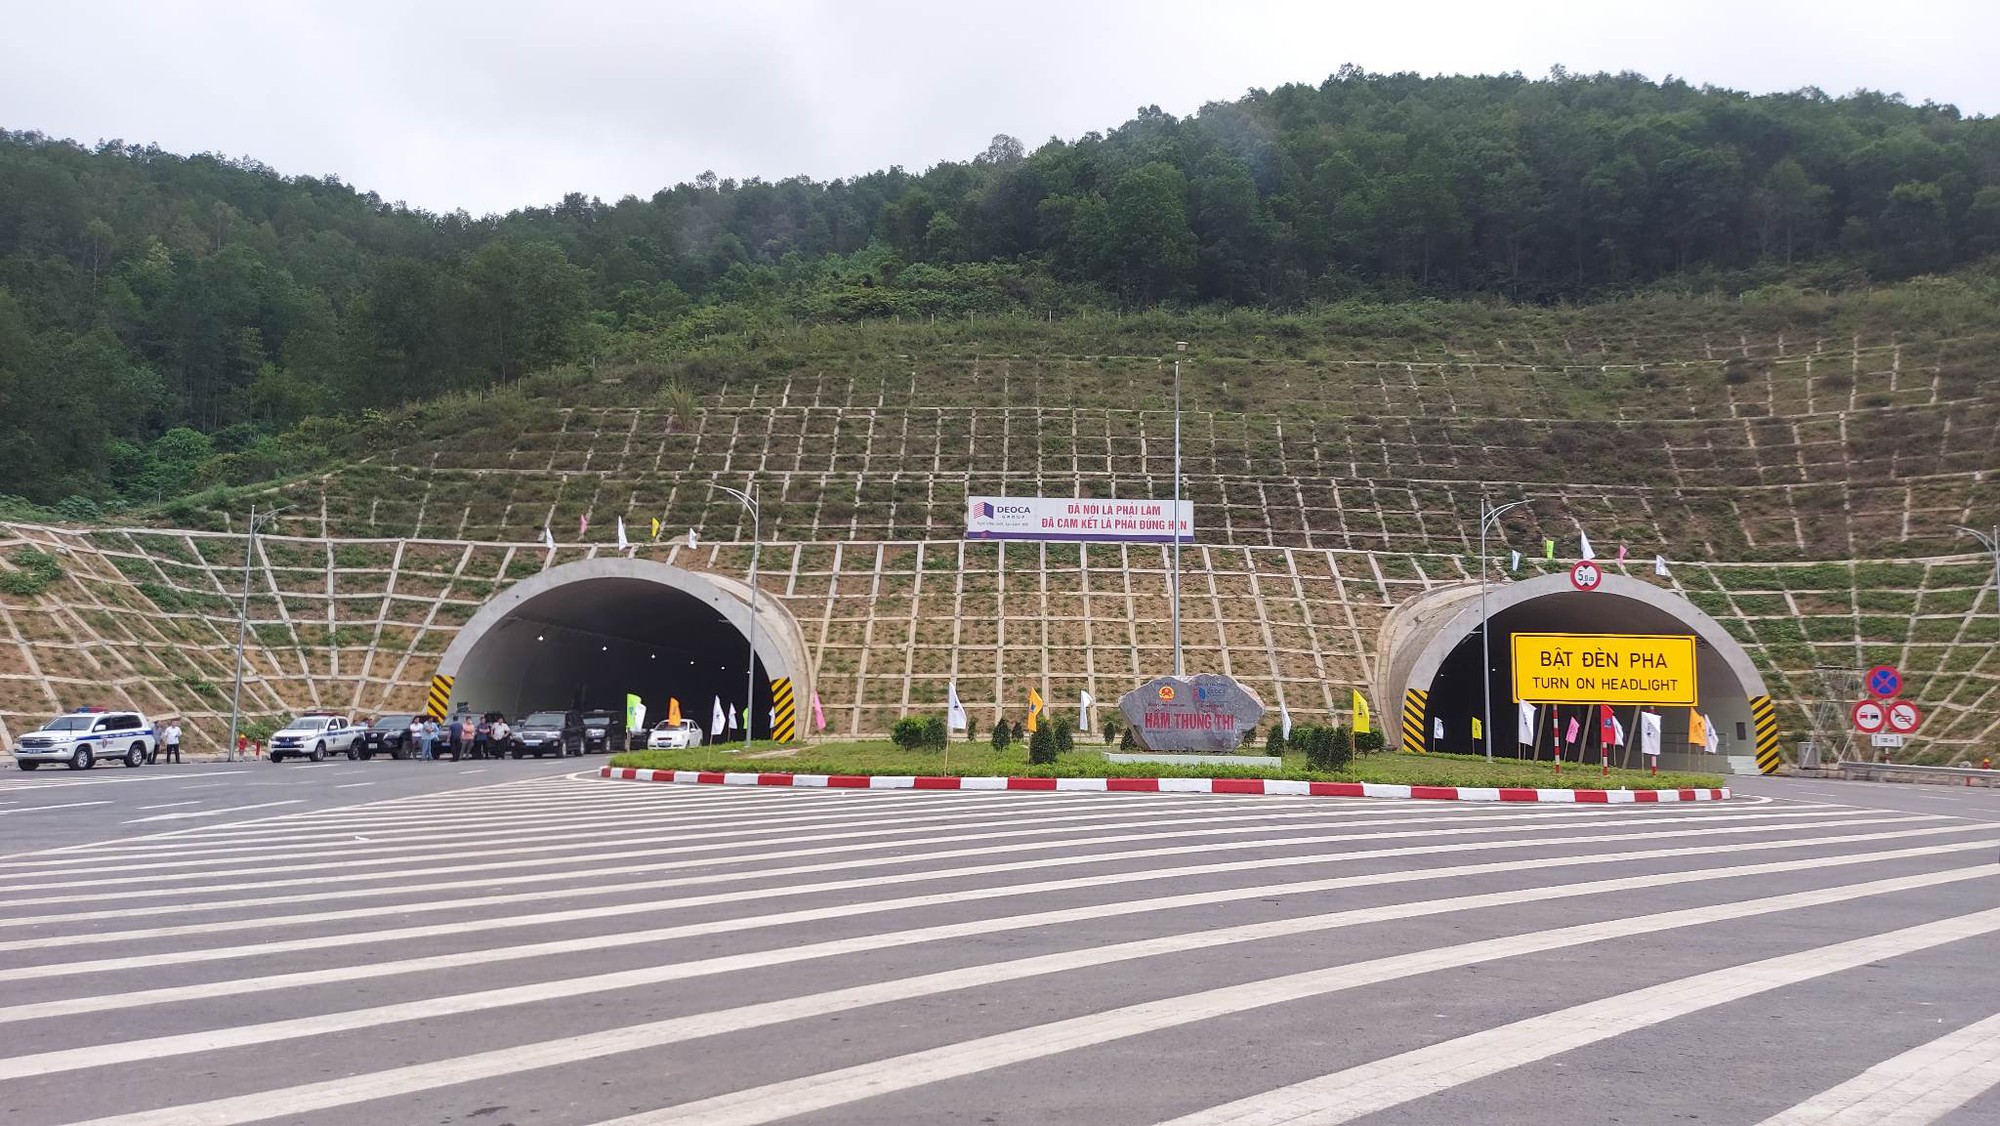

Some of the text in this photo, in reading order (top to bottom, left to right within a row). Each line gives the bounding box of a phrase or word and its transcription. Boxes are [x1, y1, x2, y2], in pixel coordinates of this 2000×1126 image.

[997, 506, 1031, 514] DEOCA
[1083, 503, 1099, 515] NÓI
[1102, 503, 1113, 515] LÀ
[1116, 502, 1138, 515] PHẢI
[1141, 503, 1161, 516] LÀM
[1041, 516, 1054, 528] ĐÃ
[1057, 518, 1078, 528] CAM
[1081, 516, 1098, 529] KẾT
[1101, 517, 1112, 529] LÀ
[1115, 516, 1136, 530] PHẢI
[1139, 517, 1165, 530] ĐÚNG
[1168, 520, 1187, 530] HN
[1540, 647, 1668, 670] BẬT ĐÈN PHA
[1532, 677, 1678, 692] TURN ON HEADLIGHT
[1174, 713, 1212, 730] THUNG
[1214, 713, 1234, 730] THI
